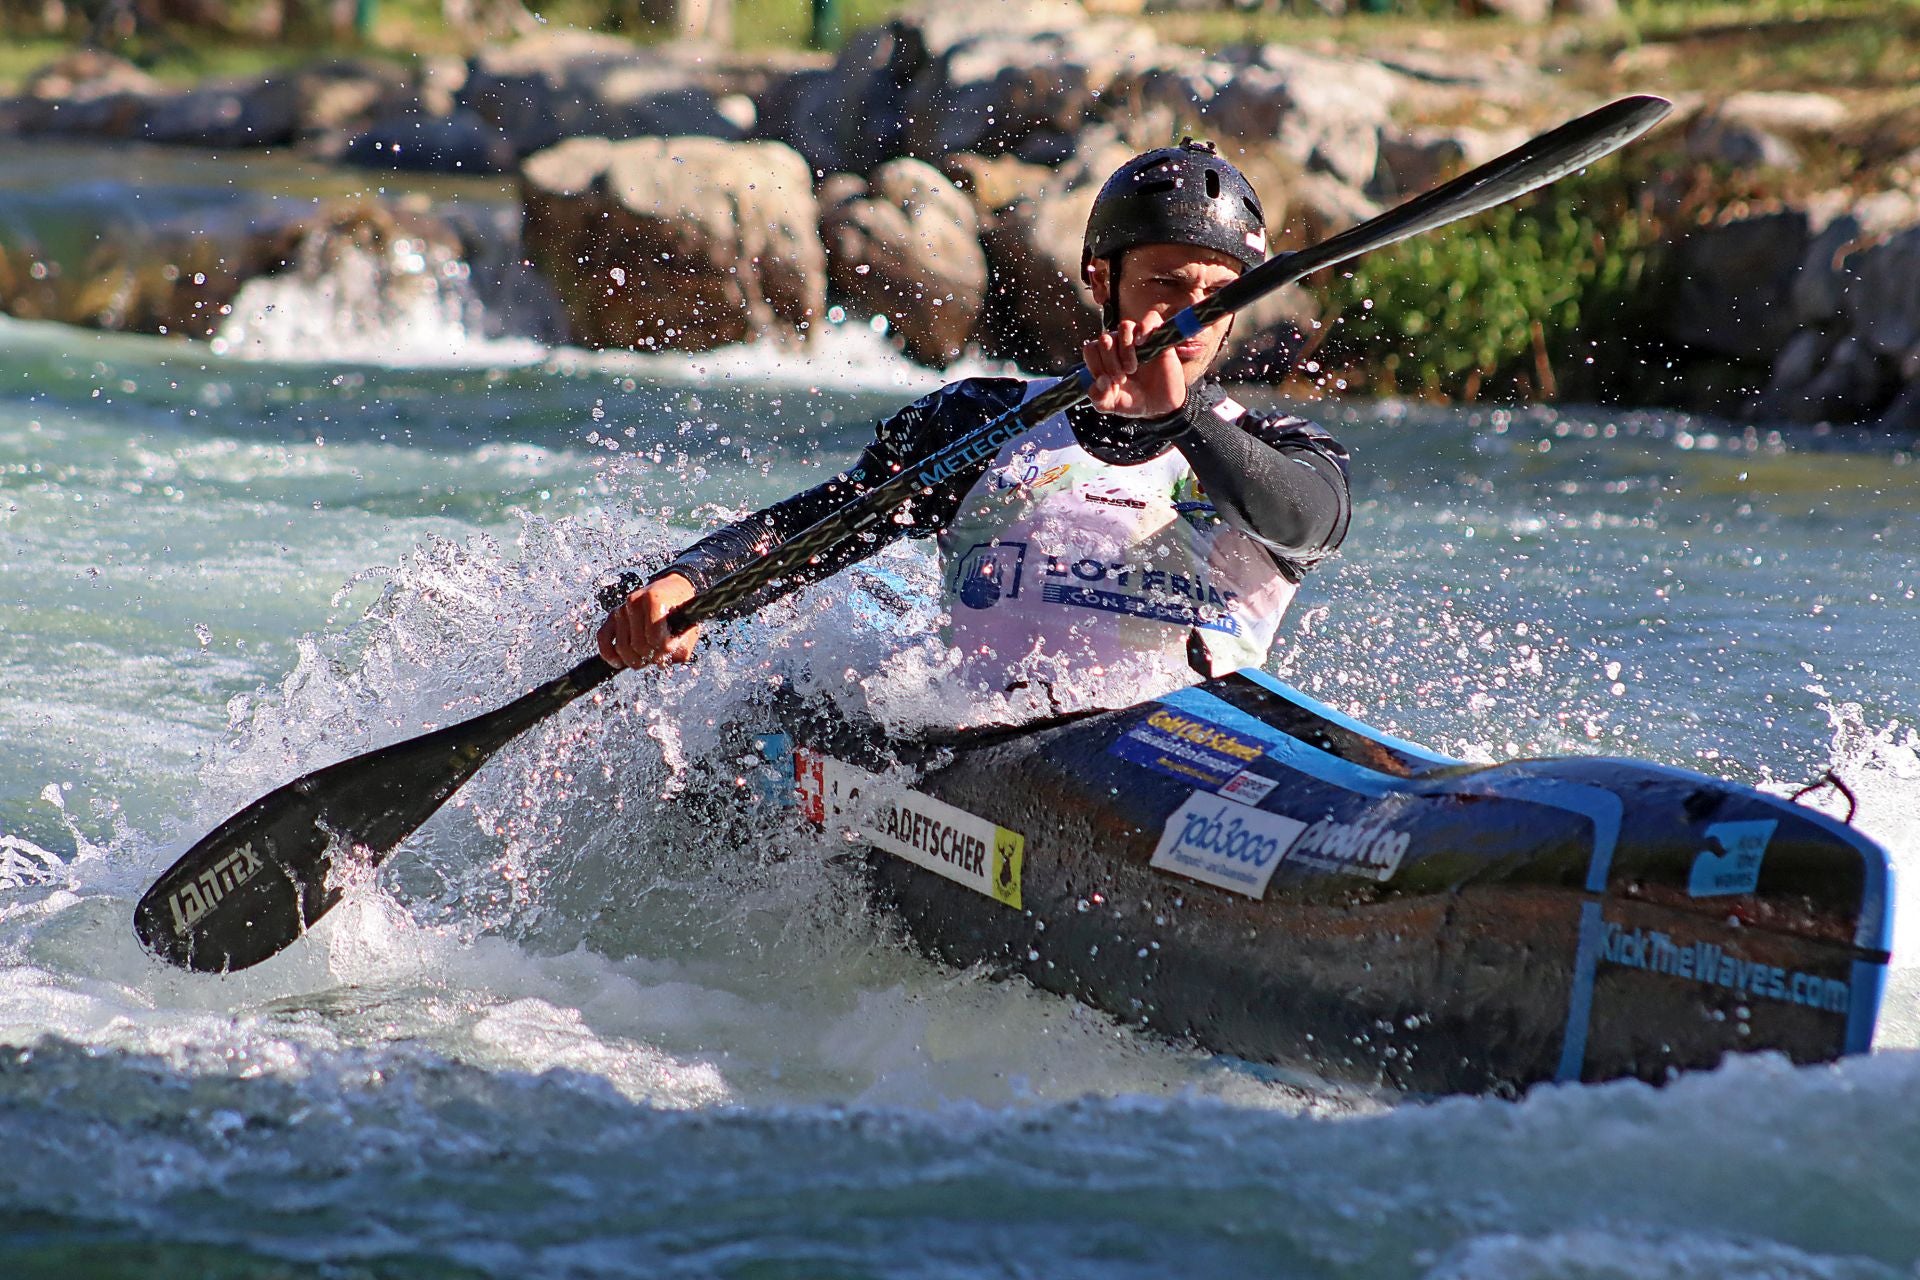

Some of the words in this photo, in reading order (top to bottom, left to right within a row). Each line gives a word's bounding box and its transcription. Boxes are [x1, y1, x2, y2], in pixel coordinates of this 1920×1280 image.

[918, 416, 1029, 487] METECH
[1071, 591, 1119, 608] CON
[1147, 711, 1188, 733] Gold
[1170, 806, 1278, 866] job3000
[1598, 921, 1849, 1013] KickTheWaves.com
